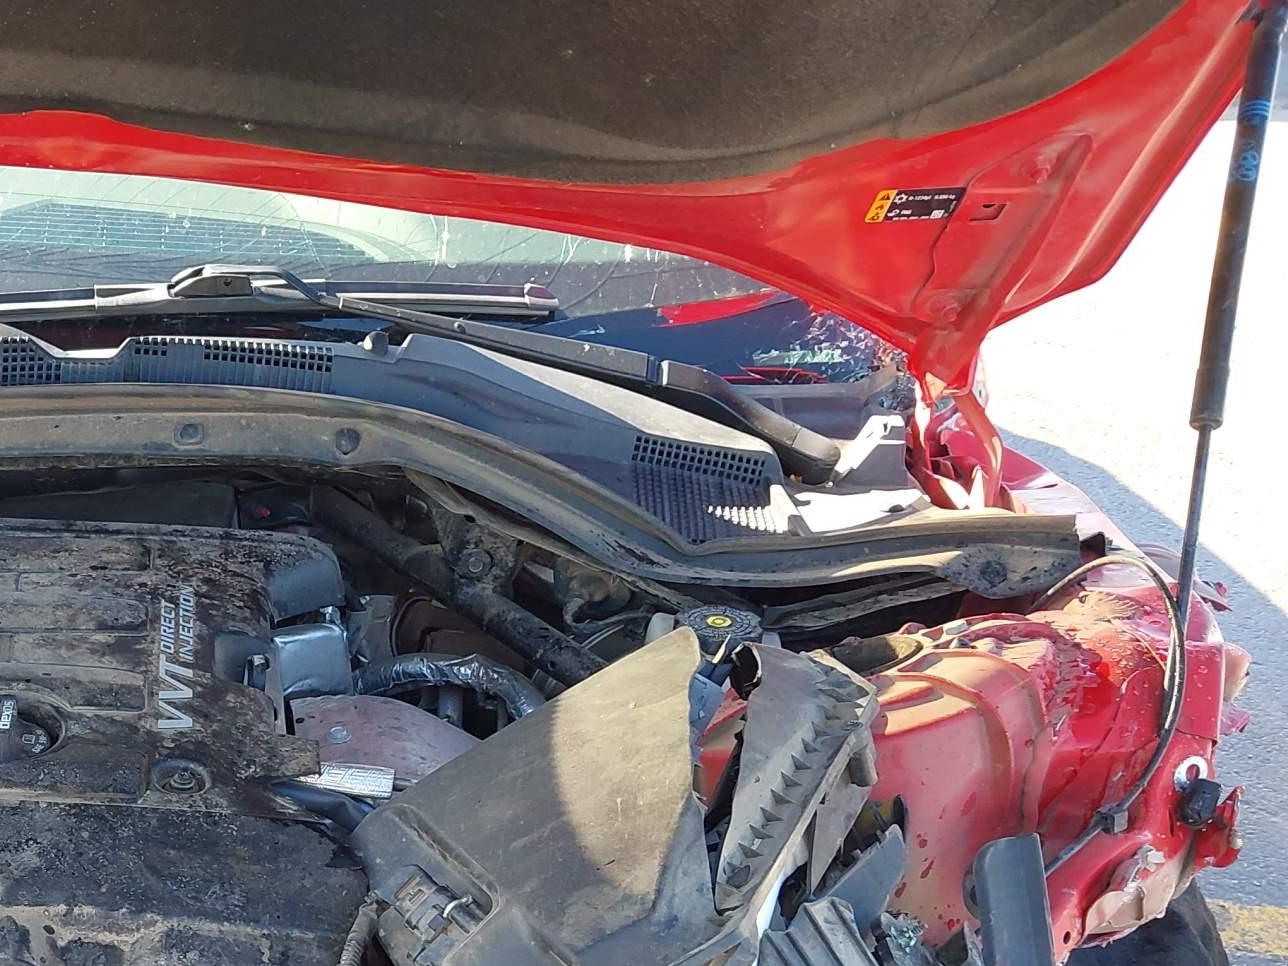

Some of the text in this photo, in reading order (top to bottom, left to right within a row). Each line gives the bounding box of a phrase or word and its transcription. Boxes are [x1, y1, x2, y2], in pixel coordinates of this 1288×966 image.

[160, 598, 176, 654] DIRECT
[179, 583, 195, 663] INJECTION
[158, 653, 194, 729] VVT
